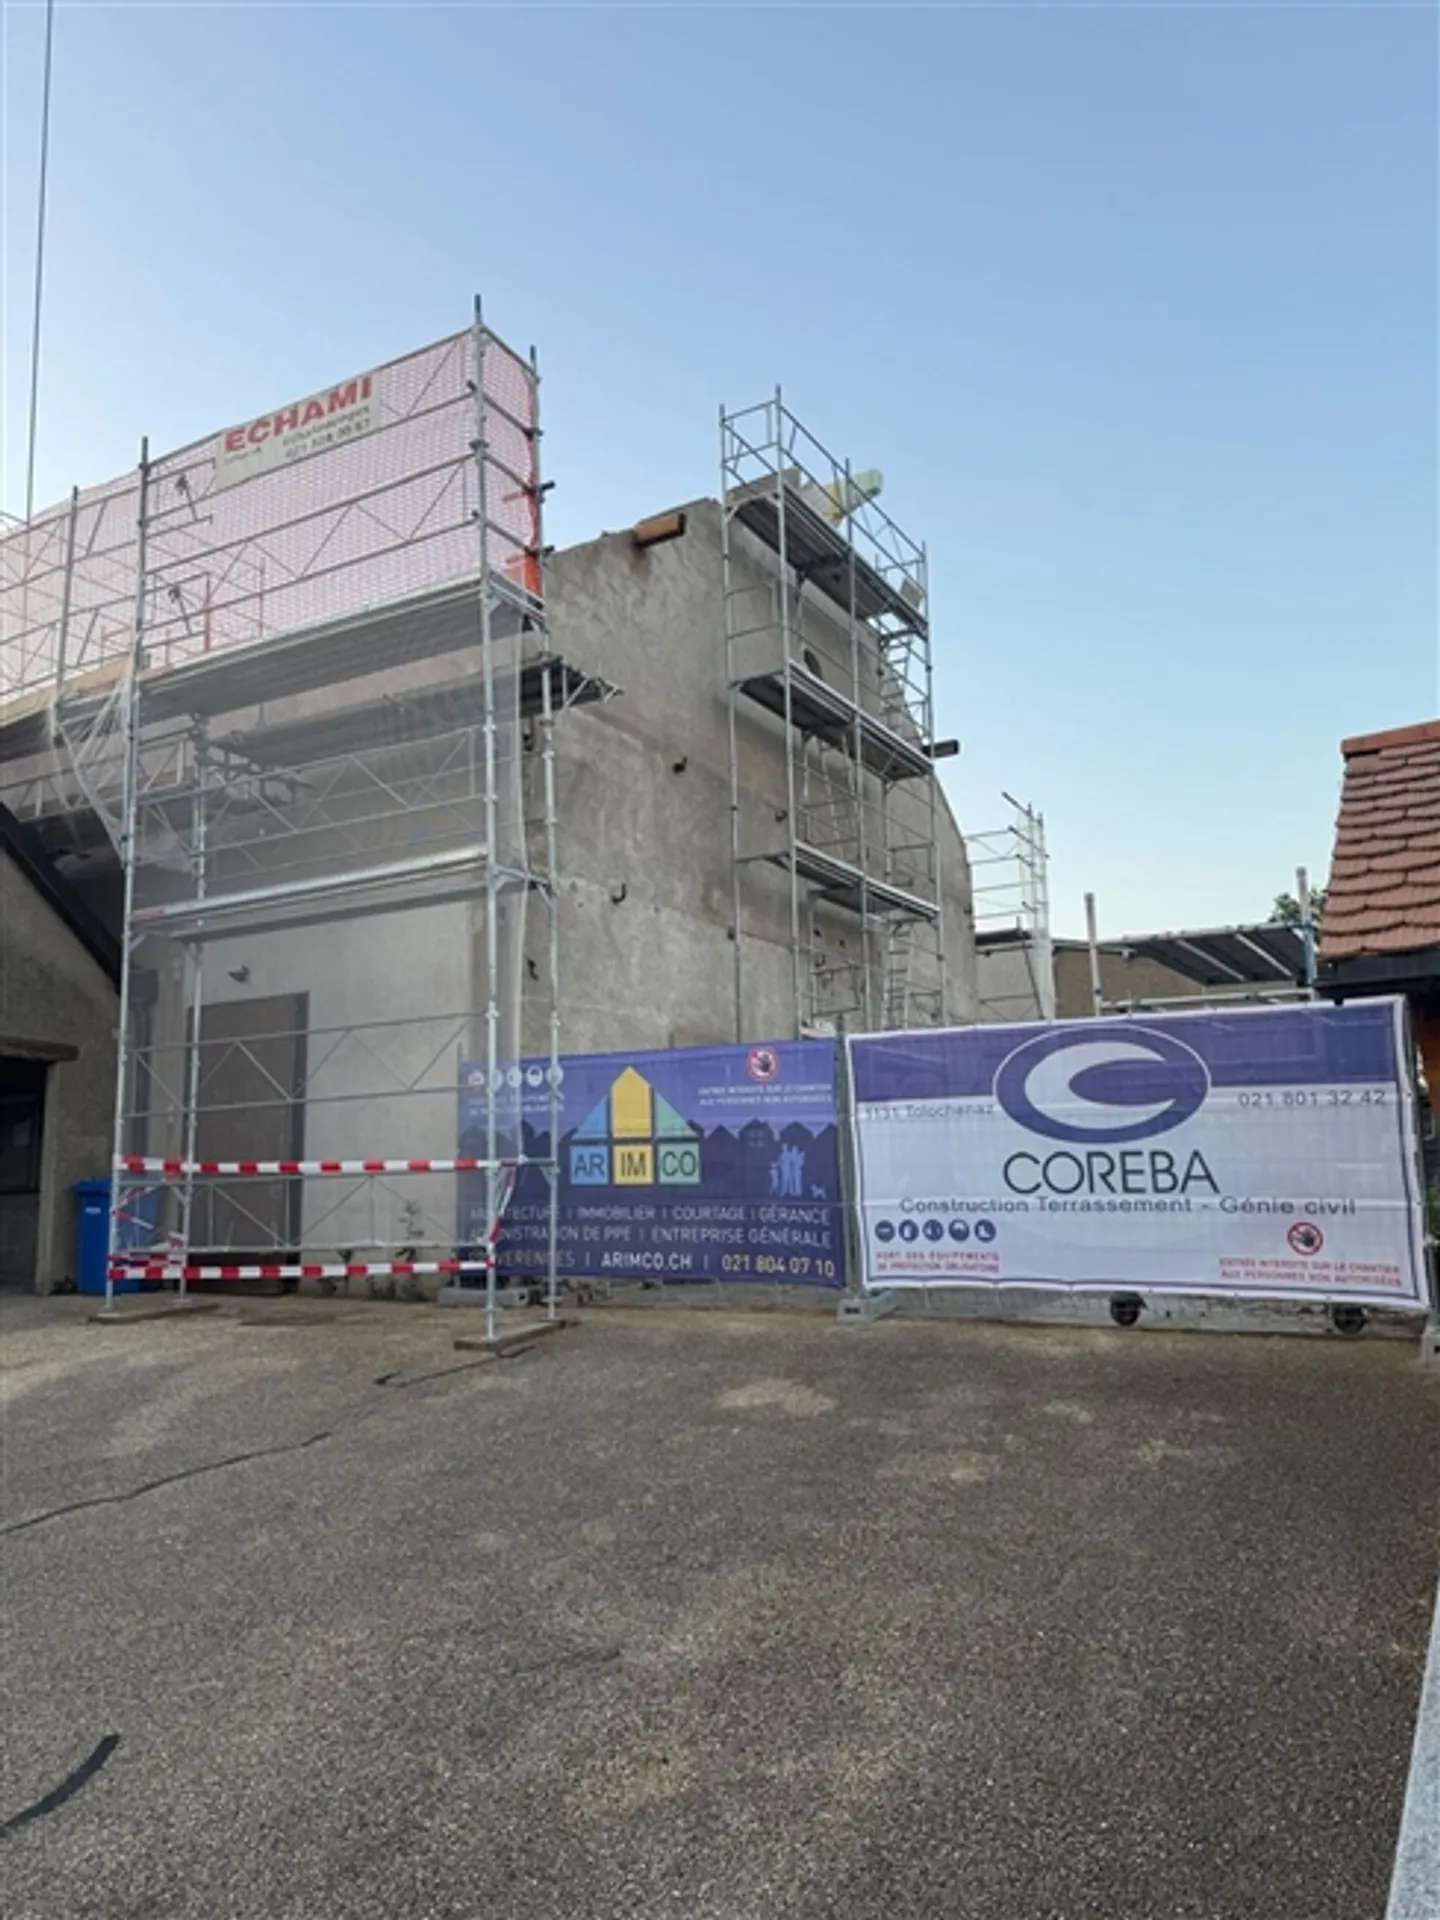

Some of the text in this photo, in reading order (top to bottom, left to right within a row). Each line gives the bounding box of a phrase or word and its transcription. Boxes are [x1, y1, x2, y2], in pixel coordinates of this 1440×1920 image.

[225, 376, 372, 453] ECHAMI
[1238, 1091, 1273, 1107] 021
[1328, 1089, 1352, 1106] 32
[1360, 1089, 1386, 1106] 42
[573, 1150, 697, 1178] AR IM CO
[1003, 1150, 1218, 1195] COREBA
[469, 1206, 561, 1221] ARTECTUR
[578, 1206, 656, 1221] IMMOBILIER
[672, 1205, 746, 1221] COURTAGE
[758, 1204, 831, 1226] GÉRANCE
[900, 1197, 1029, 1214] Construction
[1037, 1196, 1192, 1214] Terrassement
[1219, 1196, 1294, 1214] Génie
[1304, 1198, 1356, 1215] civil
[469, 1227, 579, 1242] ANISTRAON
[583, 1227, 601, 1241] DE
[604, 1227, 631, 1241] PPE
[651, 1227, 744, 1244] ENTREPRISE
[601, 1252, 692, 1271] ARIMCO.CH
[721, 1253, 749, 1272] 021
[755, 1255, 785, 1274] 804
[789, 1256, 810, 1275] 07
[815, 1258, 835, 1278] 10
